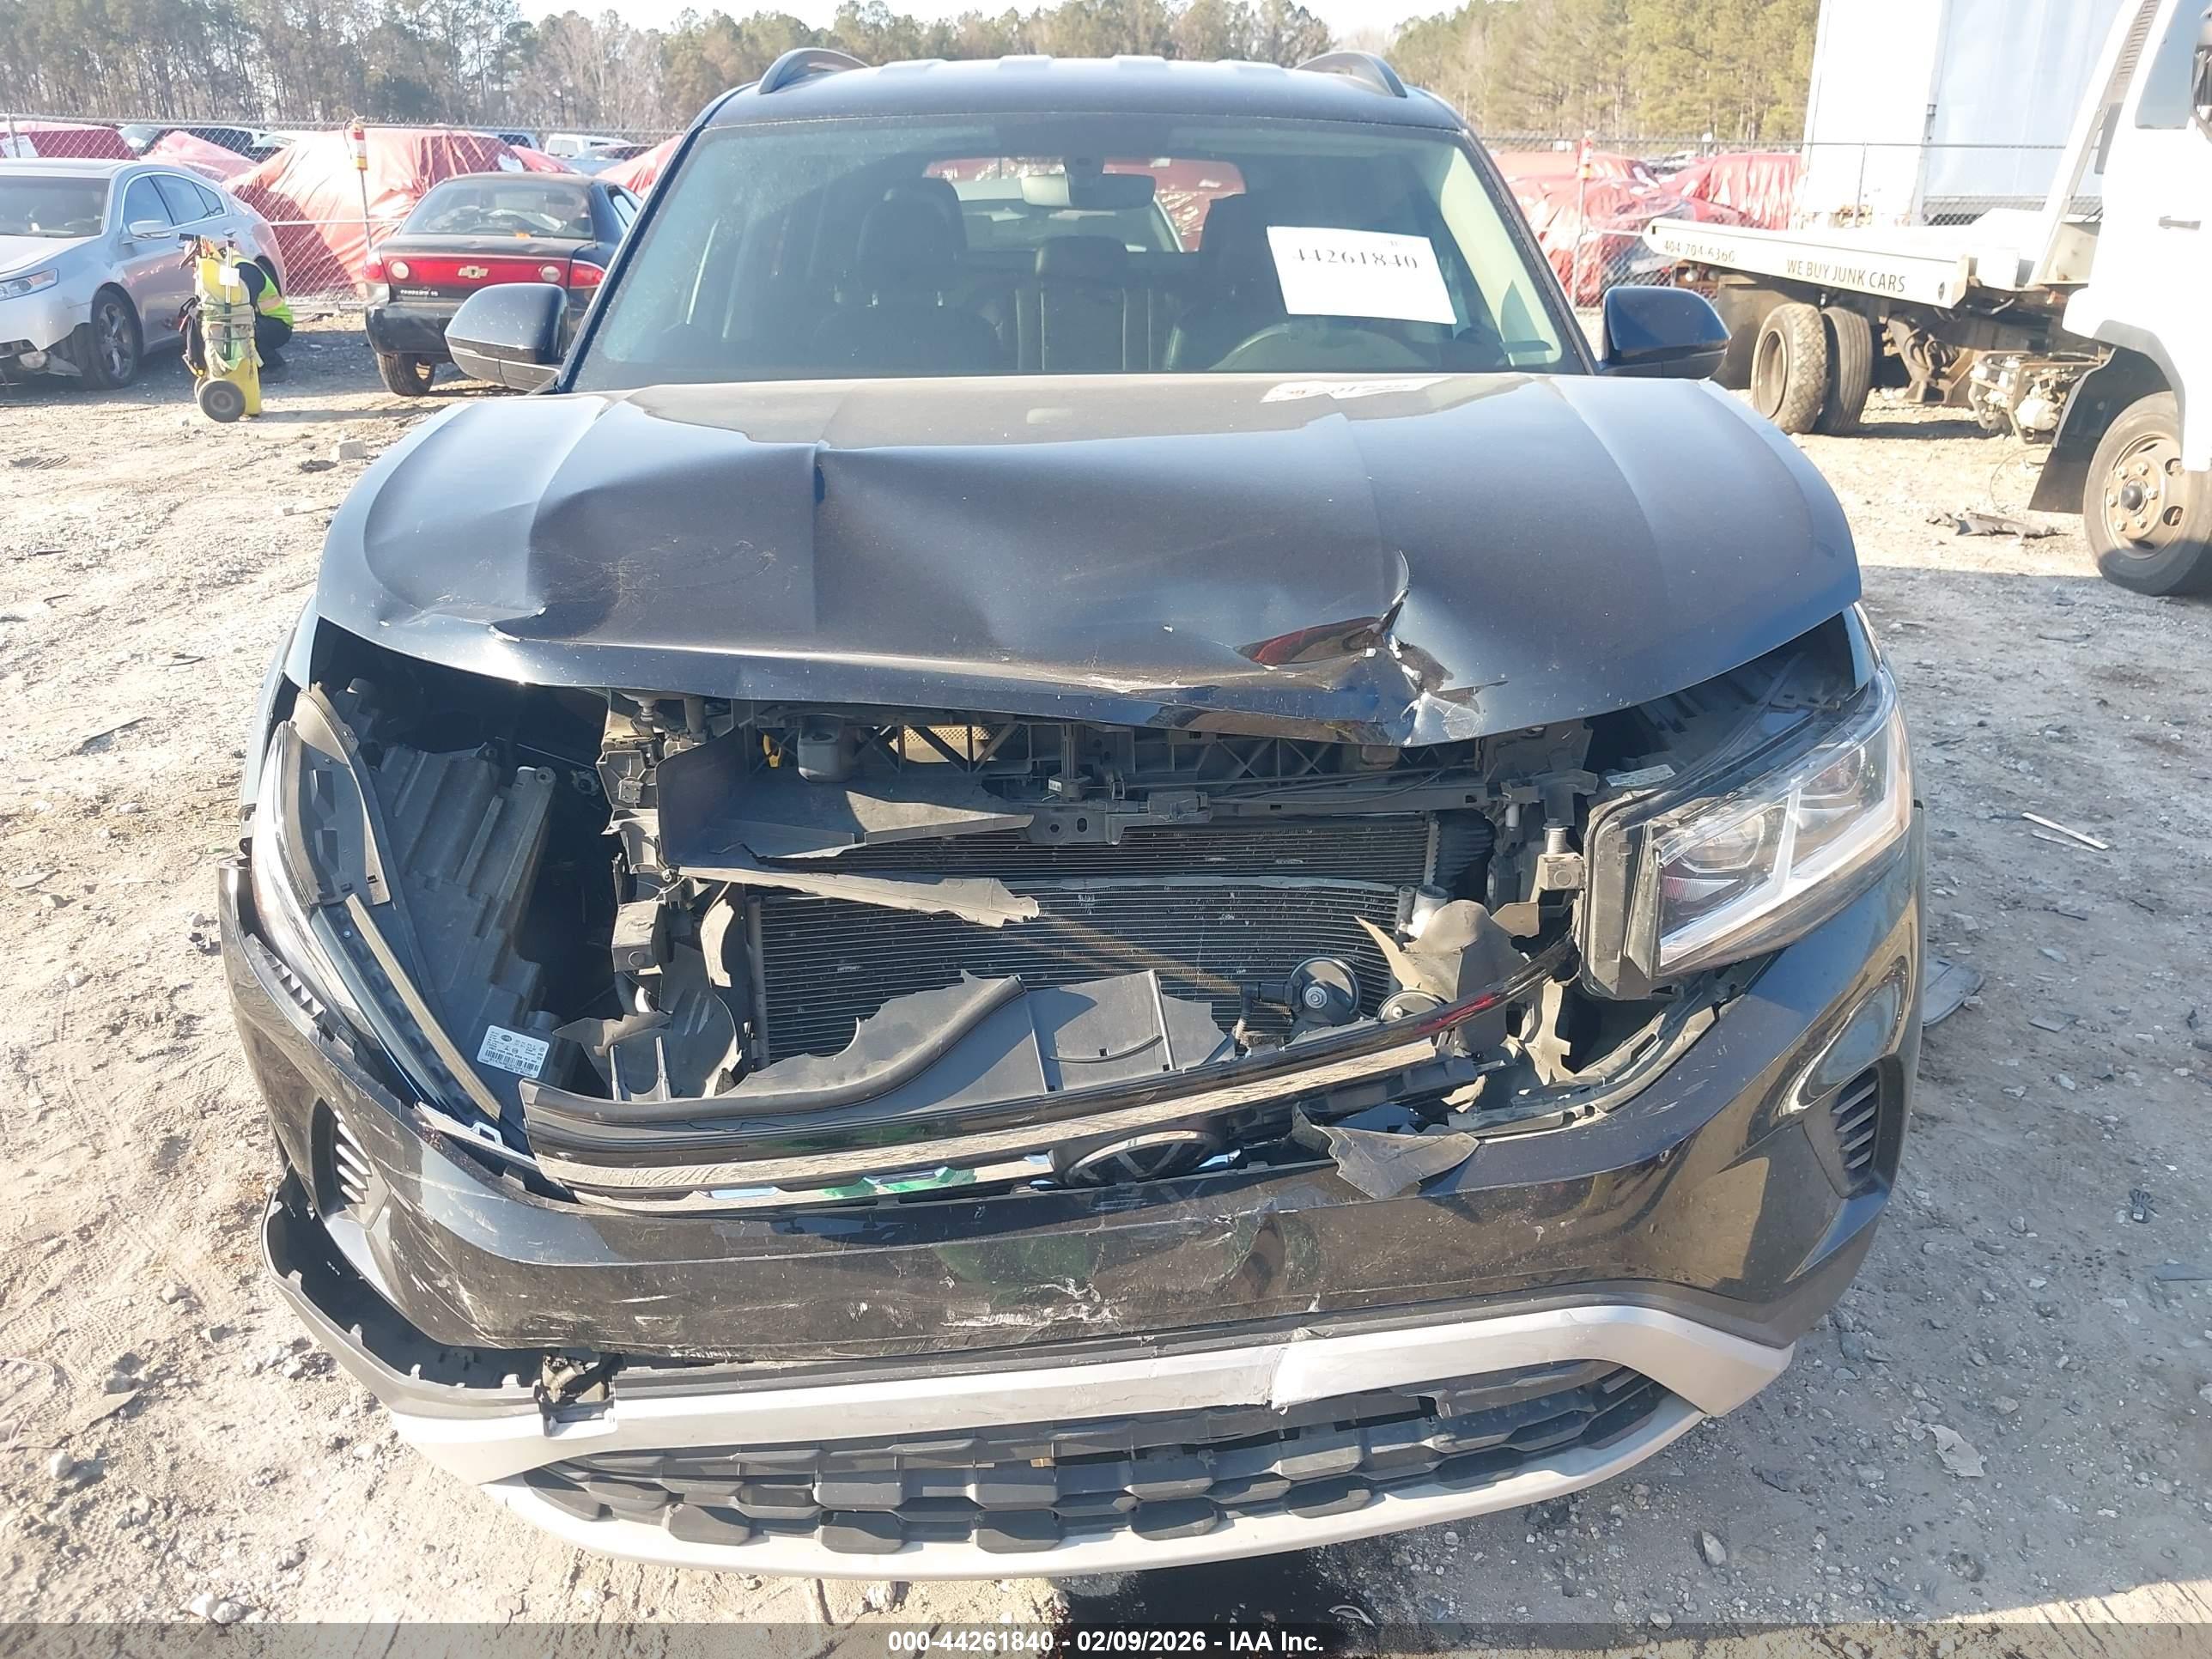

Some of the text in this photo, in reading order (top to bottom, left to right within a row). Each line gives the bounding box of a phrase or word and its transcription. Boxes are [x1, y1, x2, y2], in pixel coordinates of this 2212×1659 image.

[1292, 248, 1419, 269] 44261840
[1786, 258, 1907, 293] WE BUY JUNK CARS
